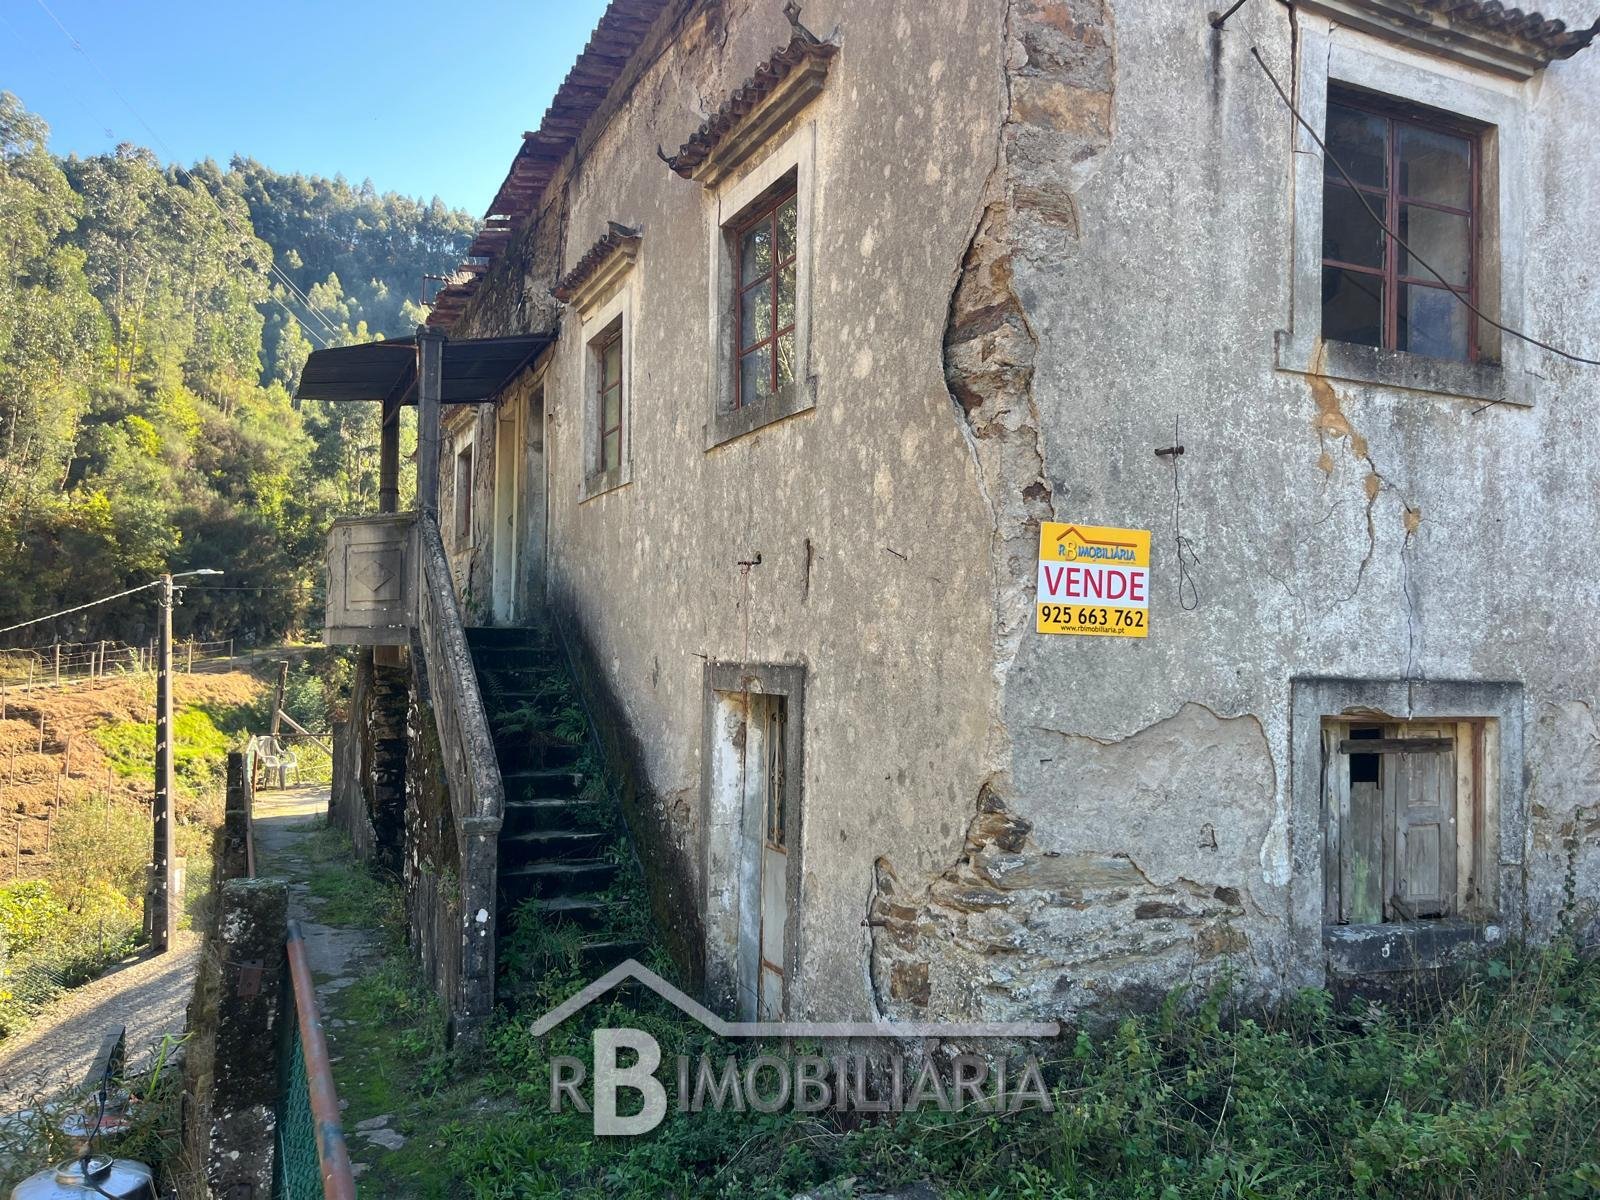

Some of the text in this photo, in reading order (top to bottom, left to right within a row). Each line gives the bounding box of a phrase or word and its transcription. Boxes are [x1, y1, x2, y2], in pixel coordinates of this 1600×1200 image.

[1044, 565, 1144, 601] VENDE
[1042, 605, 1144, 628] 925 663 762
[1061, 625, 1125, 634] www.rbimobiliaria.pt
